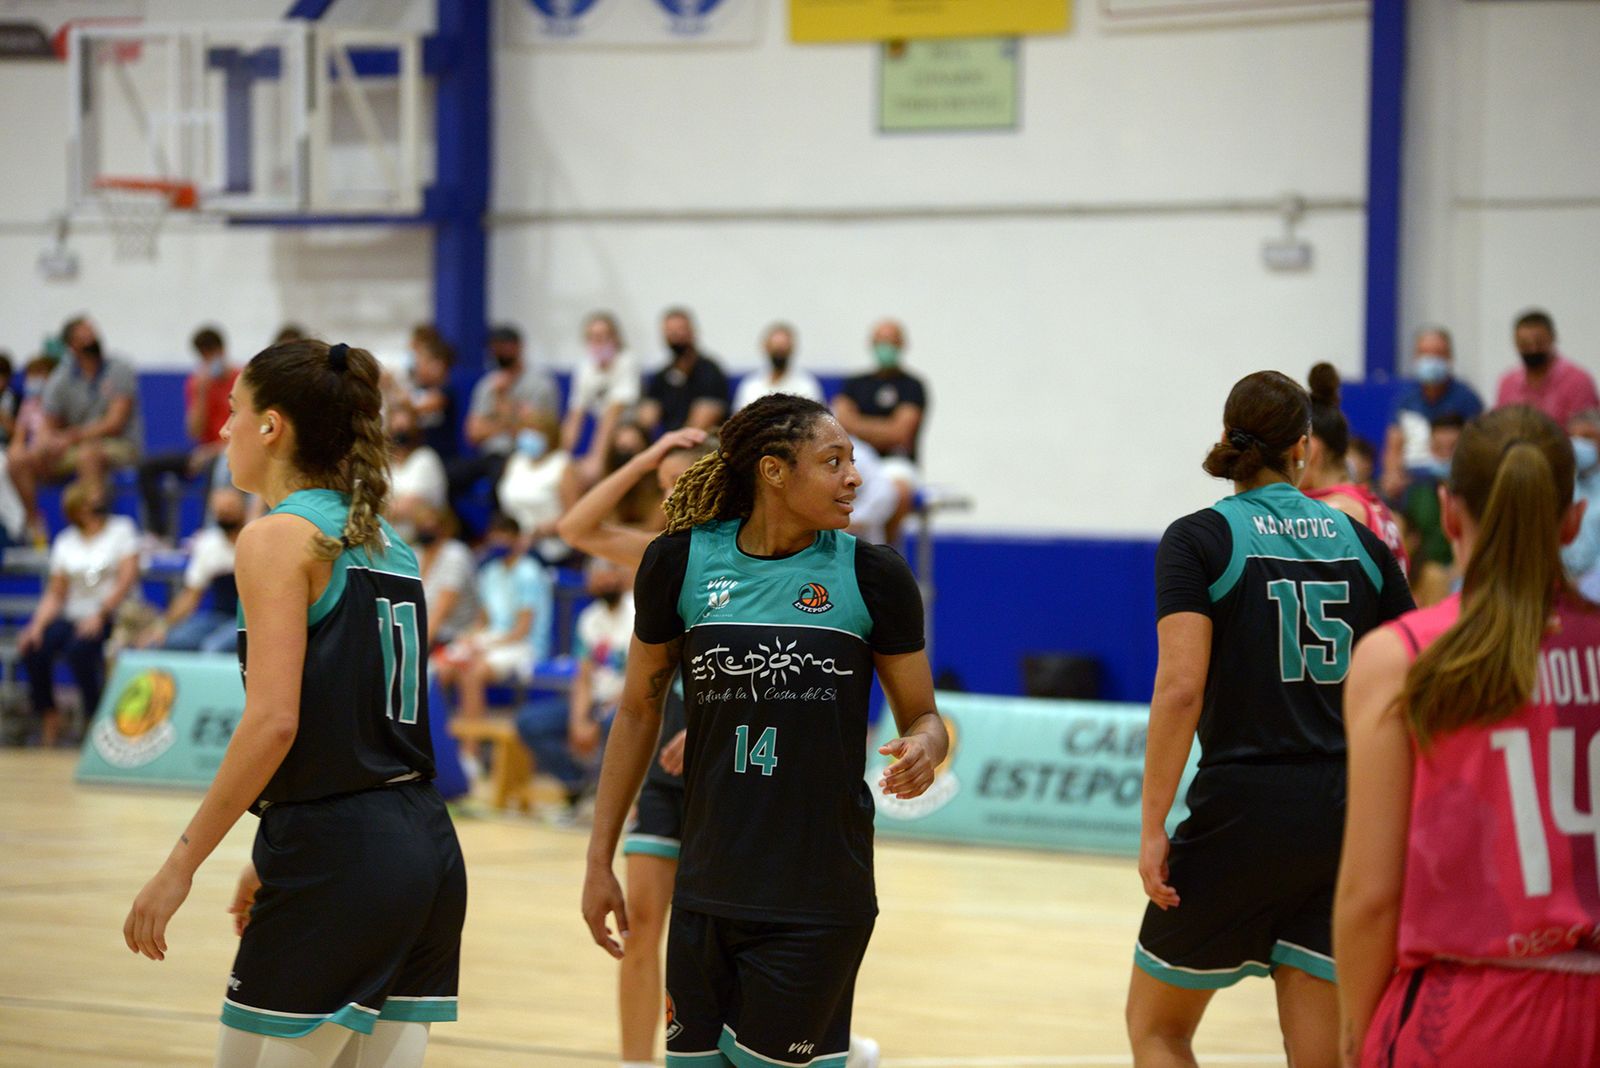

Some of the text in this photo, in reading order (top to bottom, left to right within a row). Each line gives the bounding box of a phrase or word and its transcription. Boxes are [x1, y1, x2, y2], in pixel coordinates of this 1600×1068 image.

[793, 601, 833, 614] ESTEPONA
[1266, 578, 1354, 684] 15
[375, 597, 420, 725] 11
[1532, 645, 1600, 706] OLI
[763, 686, 798, 701] Costa
[800, 686, 821, 702] del
[734, 724, 777, 776] 14
[977, 761, 1144, 807] ESTEPO
[1490, 727, 1600, 898] 14
